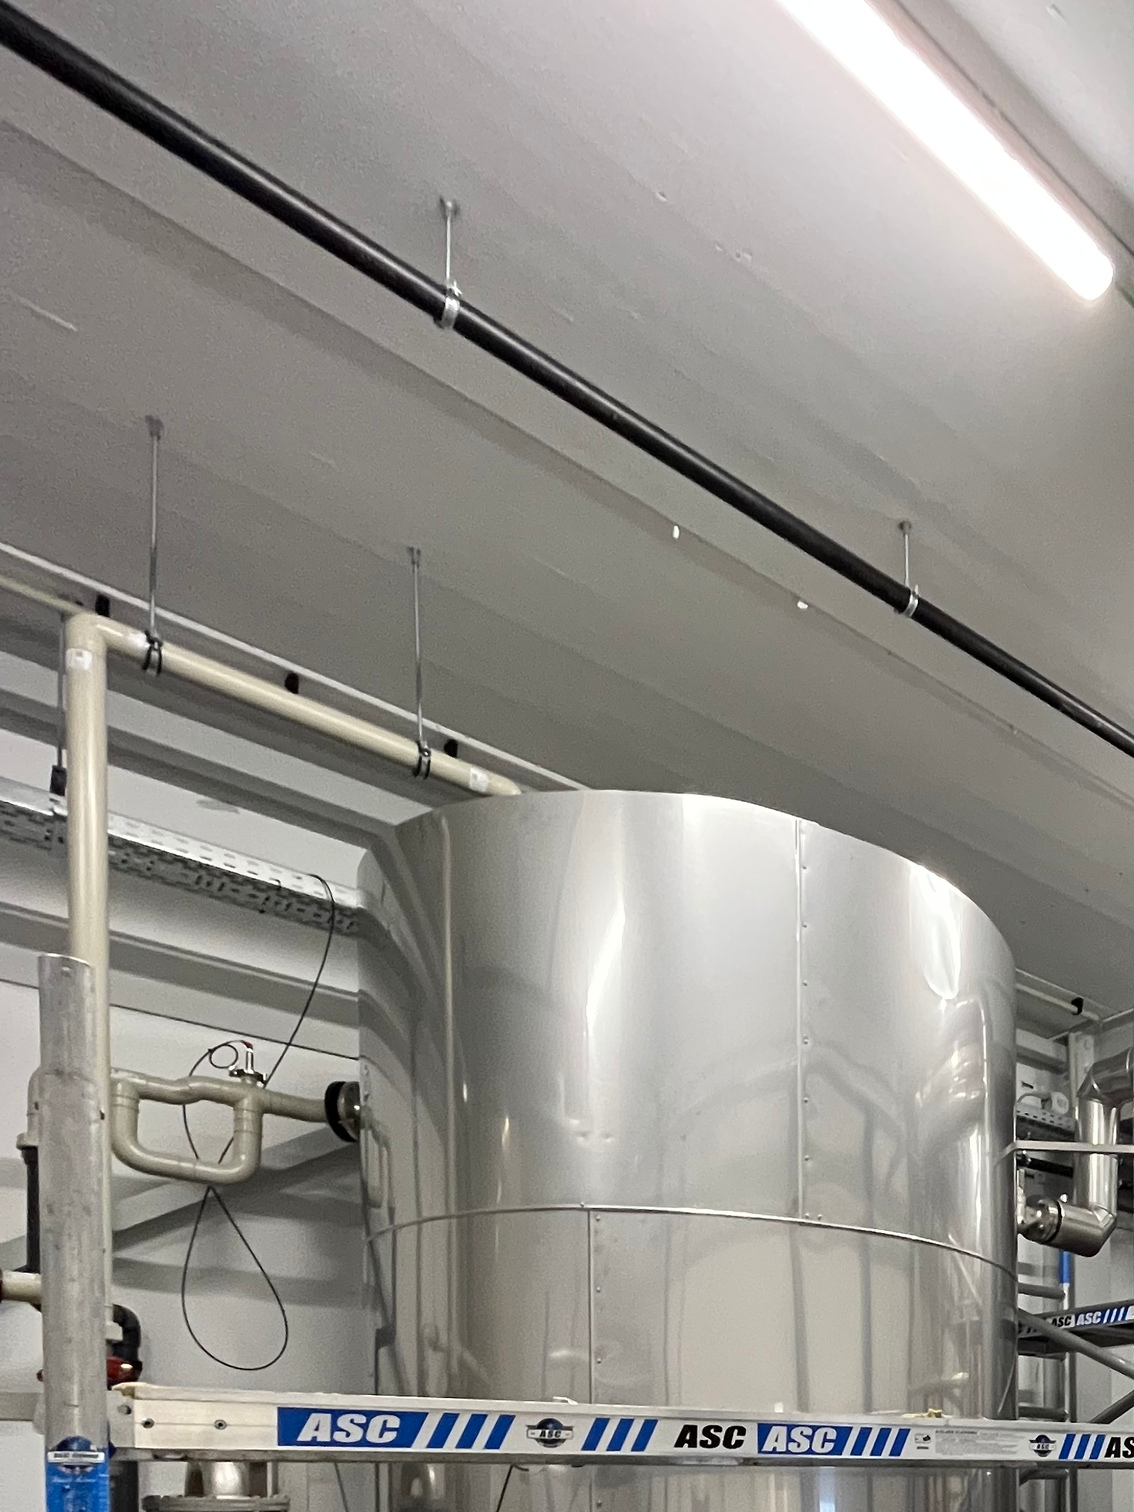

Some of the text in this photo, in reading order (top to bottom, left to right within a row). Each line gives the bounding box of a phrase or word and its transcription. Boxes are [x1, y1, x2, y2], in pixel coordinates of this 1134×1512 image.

[1076, 1311, 1102, 1326] ASC
[297, 1413, 401, 1443] ASC
[540, 1429, 561, 1438] ASC
[674, 1424, 747, 1450] ASC
[761, 1426, 837, 1453] ASC
